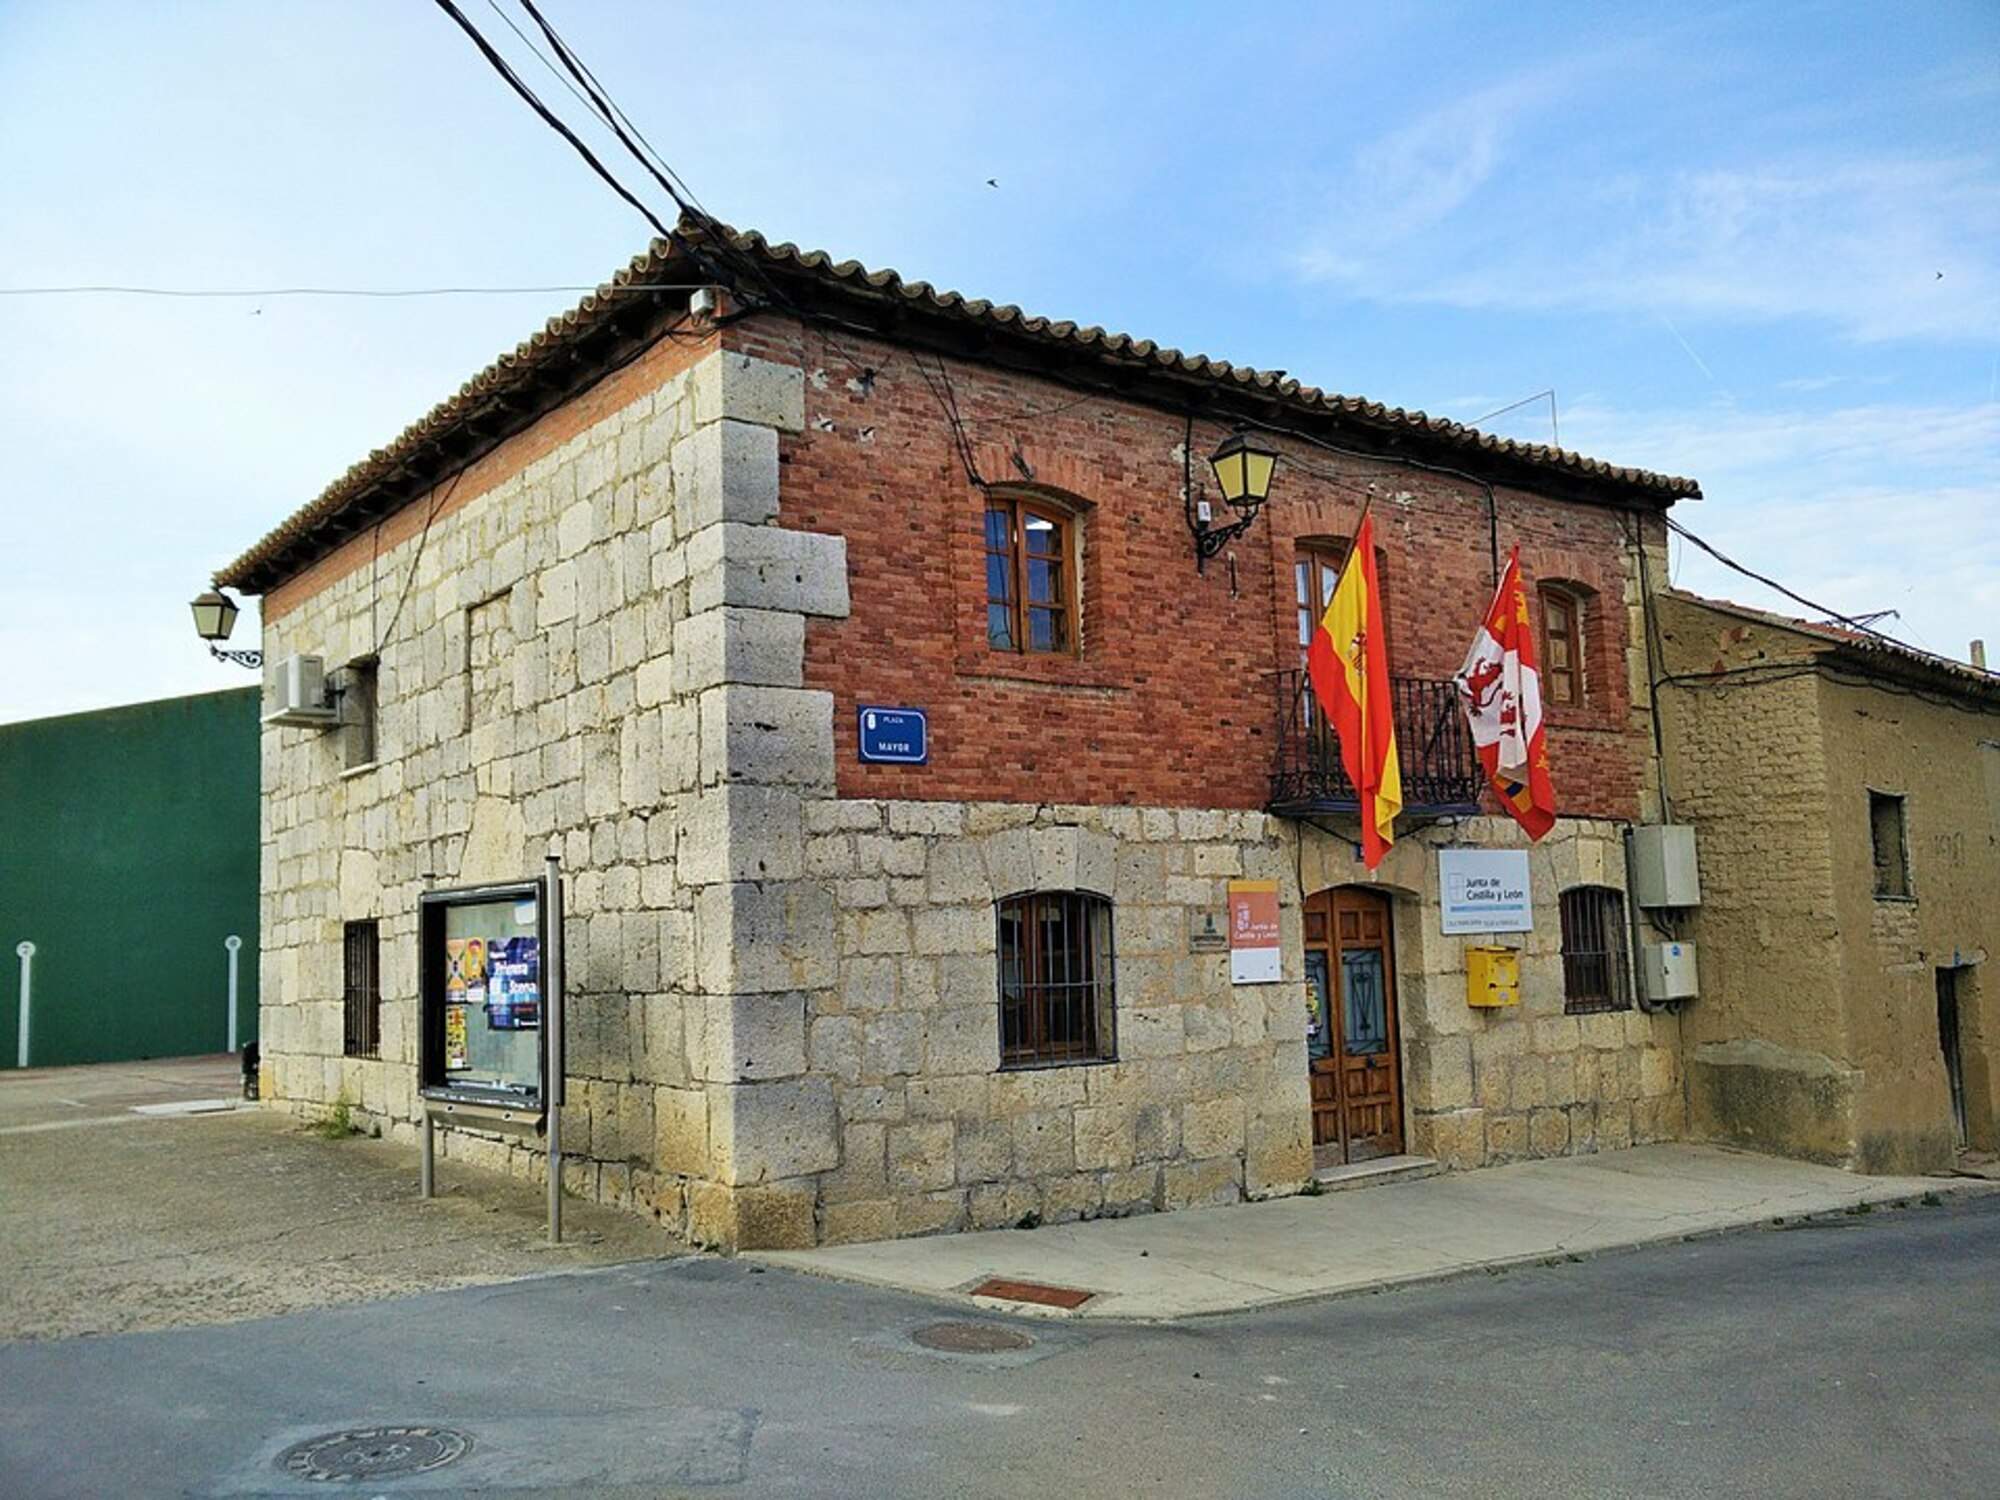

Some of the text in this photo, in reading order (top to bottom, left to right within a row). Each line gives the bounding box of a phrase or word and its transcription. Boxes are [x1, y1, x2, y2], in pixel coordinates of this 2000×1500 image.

[879, 742, 910, 752] MAYOR
[1466, 878, 1501, 888] Junta de
[1466, 889, 1495, 900] Castilla
[1496, 892, 1502, 902] y
